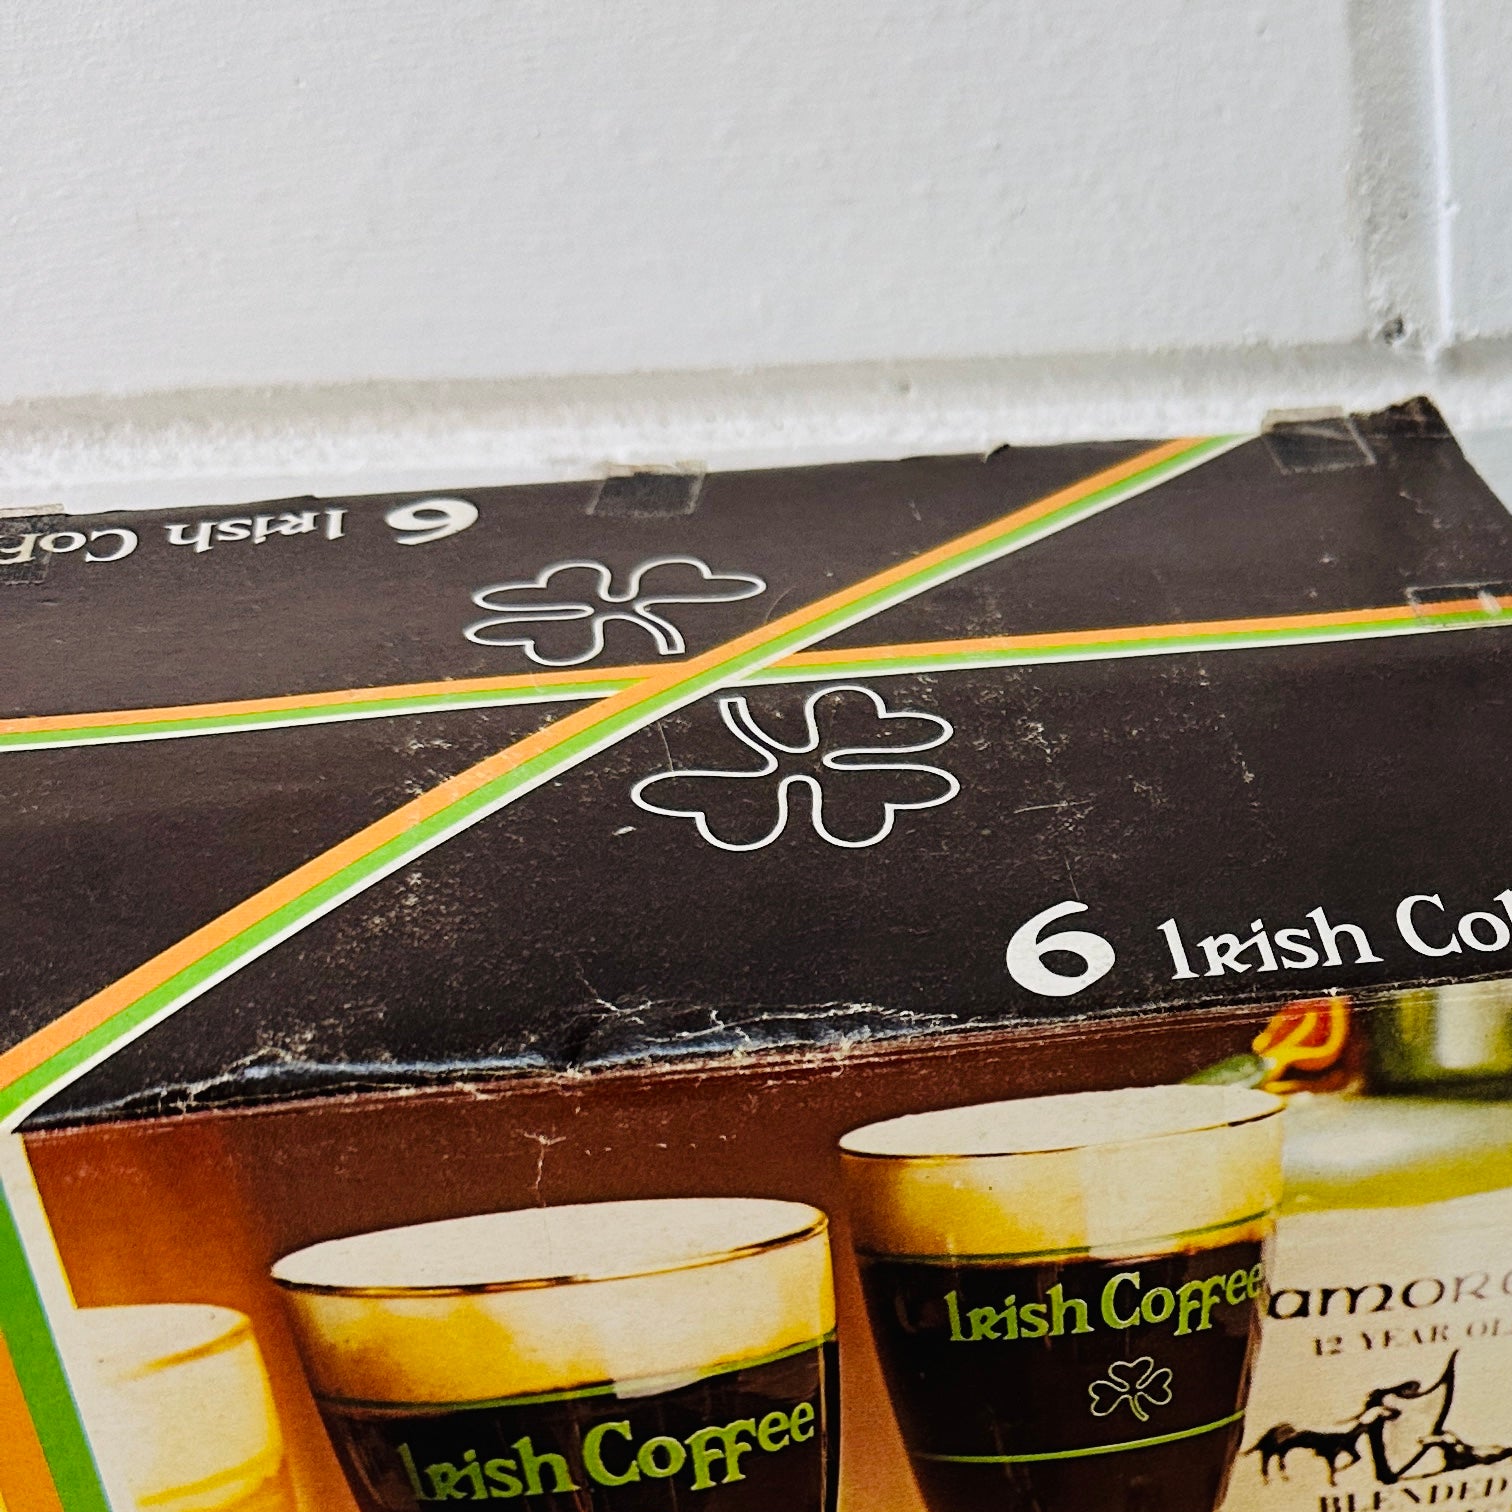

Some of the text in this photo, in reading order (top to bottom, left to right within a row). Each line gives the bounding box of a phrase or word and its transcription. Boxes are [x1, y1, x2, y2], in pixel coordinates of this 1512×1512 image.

[164, 507, 348, 554] Irish
[383, 498, 480, 546] 6
[1006, 899, 1117, 997] 6
[1157, 906, 1384, 980] Irish
[943, 1262, 1266, 1343] Irish Coffee
[1313, 1334, 1342, 1356] 12
[1360, 1327, 1449, 1352] YEAR
[398, 1401, 816, 1501] Irish Coffee
